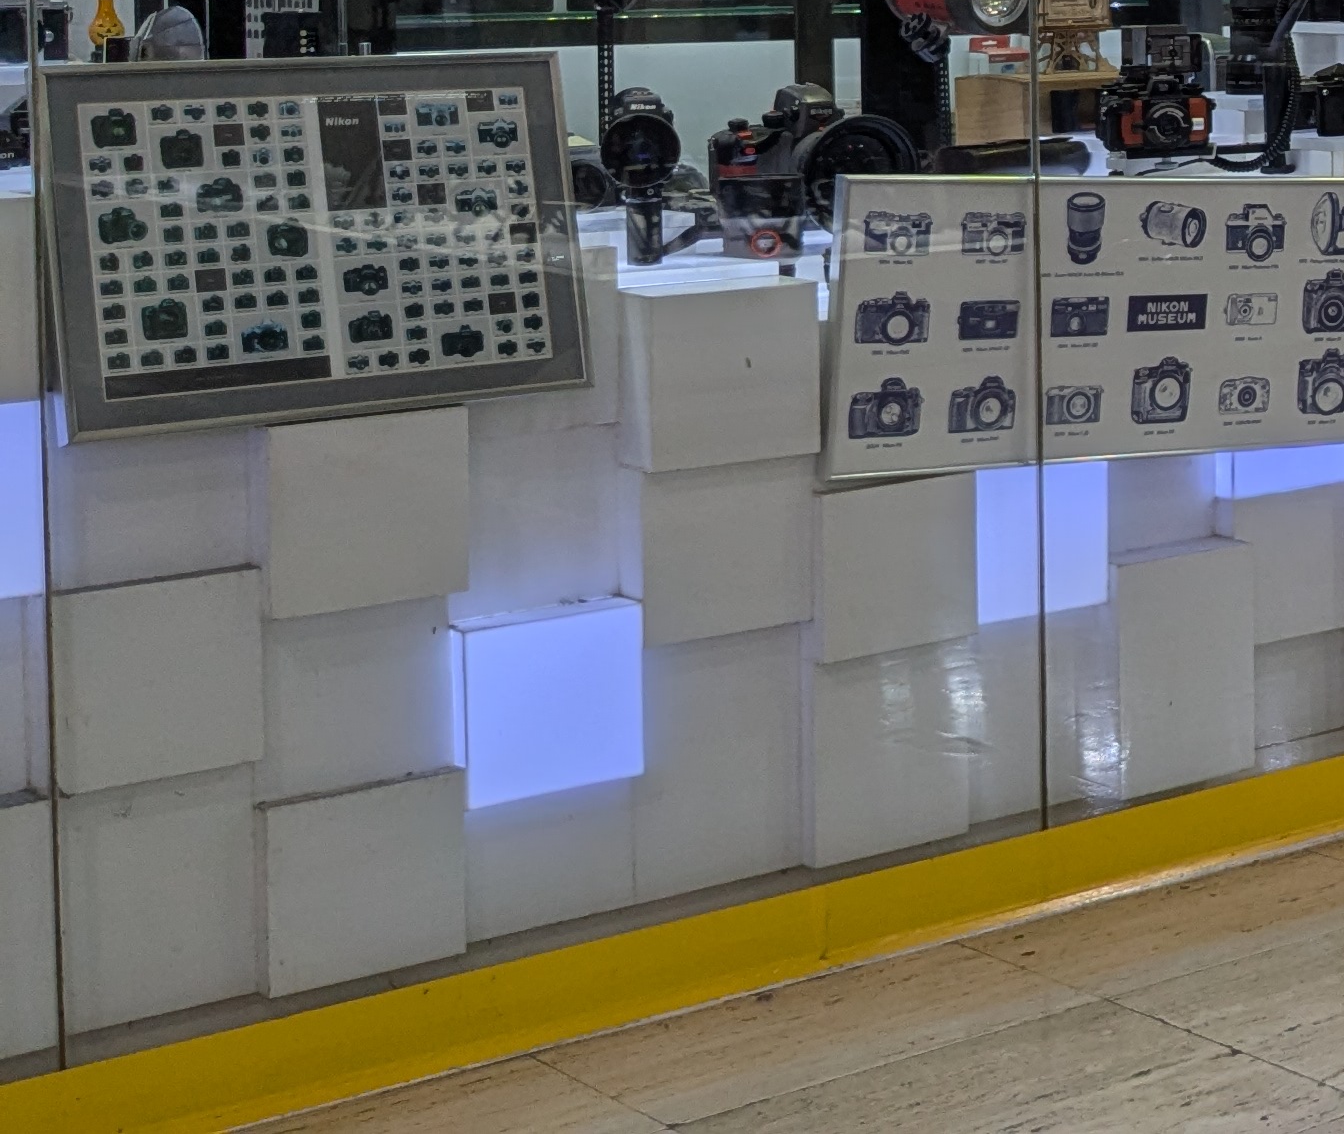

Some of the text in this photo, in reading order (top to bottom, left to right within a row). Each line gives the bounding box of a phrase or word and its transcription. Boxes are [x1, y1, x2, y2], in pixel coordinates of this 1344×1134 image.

[630, 102, 657, 111] Nikon
[324, 115, 361, 128] Nikon
[1146, 300, 1190, 314] NIKON
[1136, 312, 1197, 326] MUSEUM
